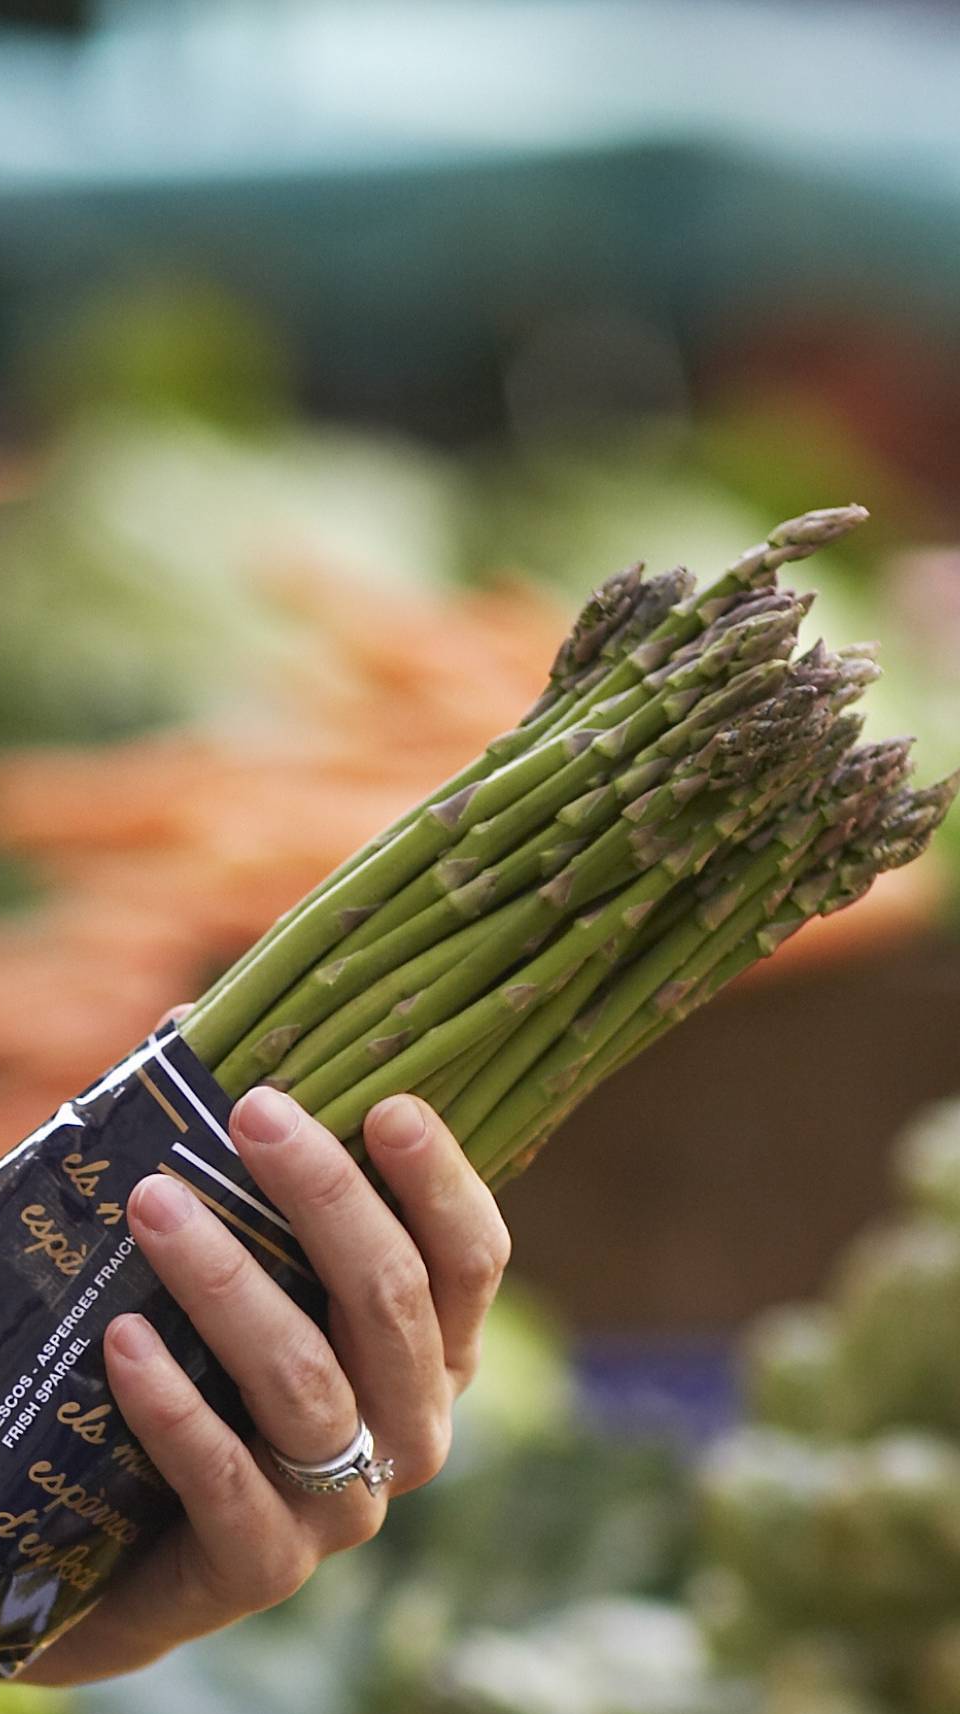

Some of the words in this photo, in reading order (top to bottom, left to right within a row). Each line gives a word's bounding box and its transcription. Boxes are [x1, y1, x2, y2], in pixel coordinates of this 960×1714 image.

[21, 1204, 88, 1276] espà
[36, 1287, 100, 1366] ASPERGES
[93, 1231, 136, 1289] FRAICH
[1, 1401, 41, 1449] FRISH
[35, 1336, 91, 1403] SPARGEL
[57, 1401, 112, 1444] els
